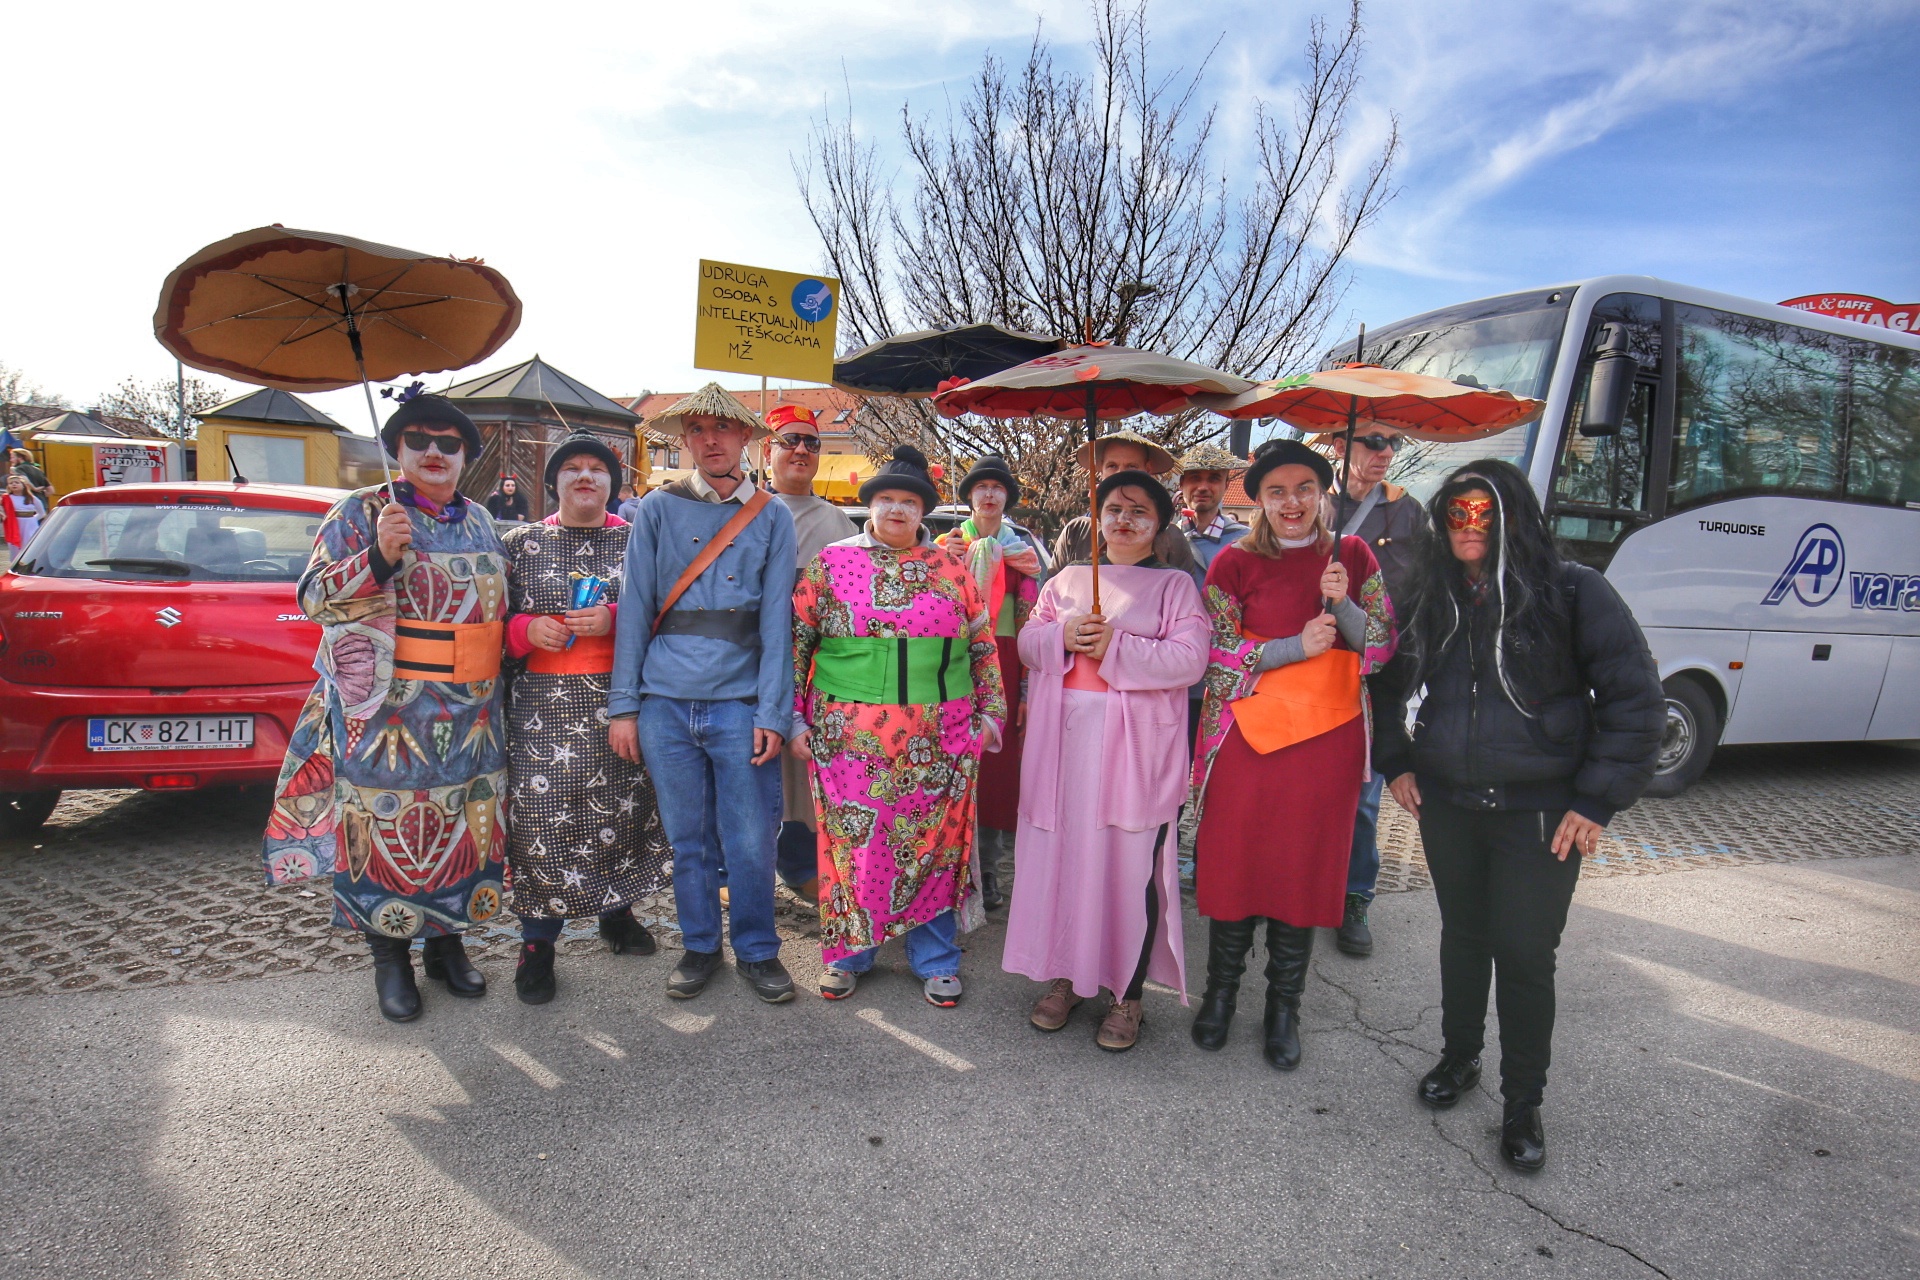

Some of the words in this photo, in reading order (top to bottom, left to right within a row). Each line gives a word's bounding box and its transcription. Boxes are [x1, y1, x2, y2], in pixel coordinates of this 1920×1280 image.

[702, 265, 769, 288] UDRUGA
[712, 287, 762, 304] OSOBA
[767, 295, 778, 307] S
[1818, 297, 1837, 310] &
[1837, 299, 1874, 311] CAFFE
[699, 304, 815, 333] INTELEKTUALNIM
[735, 324, 821, 349] TEŠKOĆAMA
[728, 340, 754, 360] MŽ
[99, 447, 162, 457] PERADARSTVO
[155, 505, 245, 513] www.suzuki-tos.hr
[1698, 520, 1766, 536] TURQUOISE
[14, 611, 63, 619] SUZUKI
[23, 654, 48, 667] HR
[158, 720, 248, 742] 821-HT
